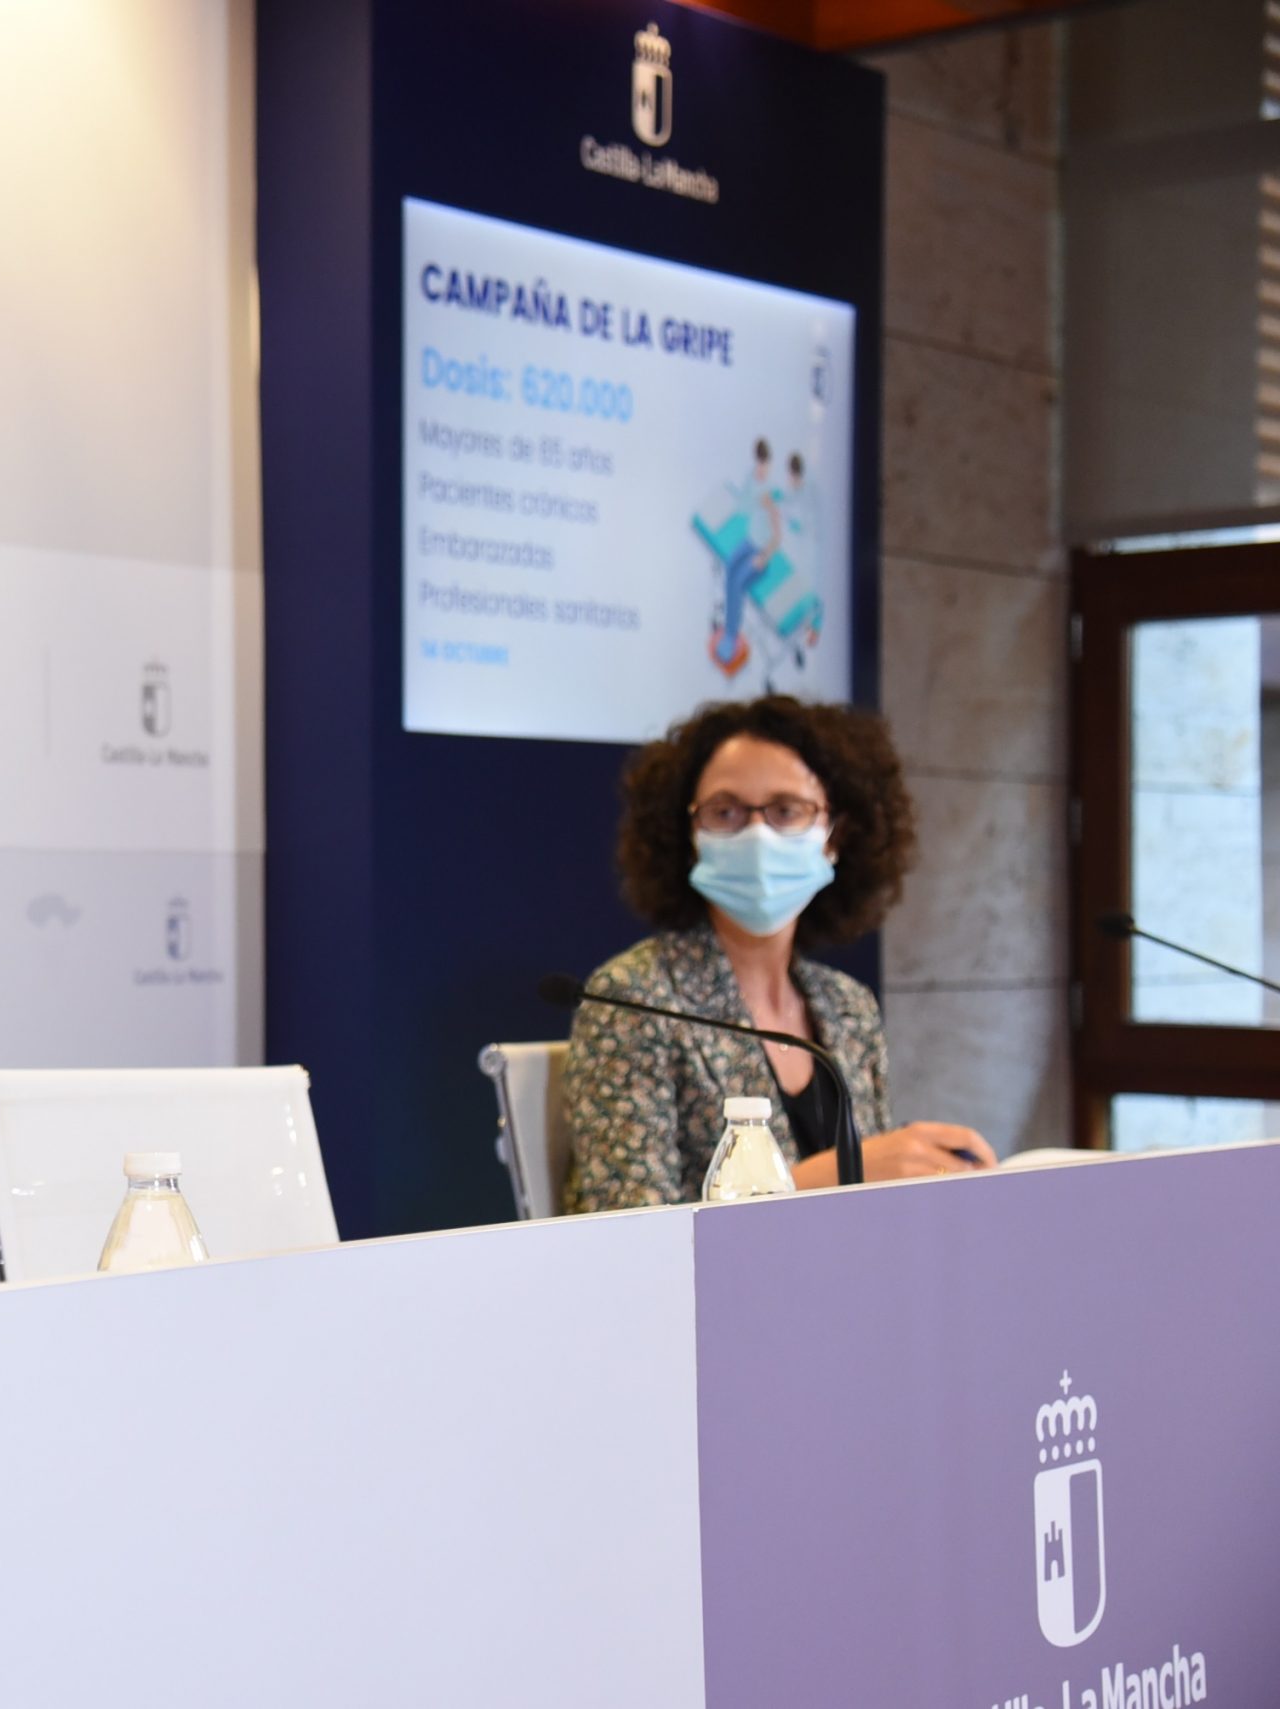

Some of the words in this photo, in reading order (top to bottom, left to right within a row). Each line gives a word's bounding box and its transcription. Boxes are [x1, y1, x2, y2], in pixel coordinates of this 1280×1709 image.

[420, 263, 571, 332] CAMPAÑA
[580, 297, 614, 341] DE
[621, 307, 655, 349] LA
[659, 316, 735, 366] GRIPE
[420, 346, 512, 401] Dosis:
[521, 362, 635, 423] 620.000
[418, 417, 503, 460] Mayores
[509, 434, 533, 463] de
[418, 468, 515, 513] Pacientes
[418, 523, 555, 571] Embarazadas
[1101, 1643, 1207, 1709] Mancha
